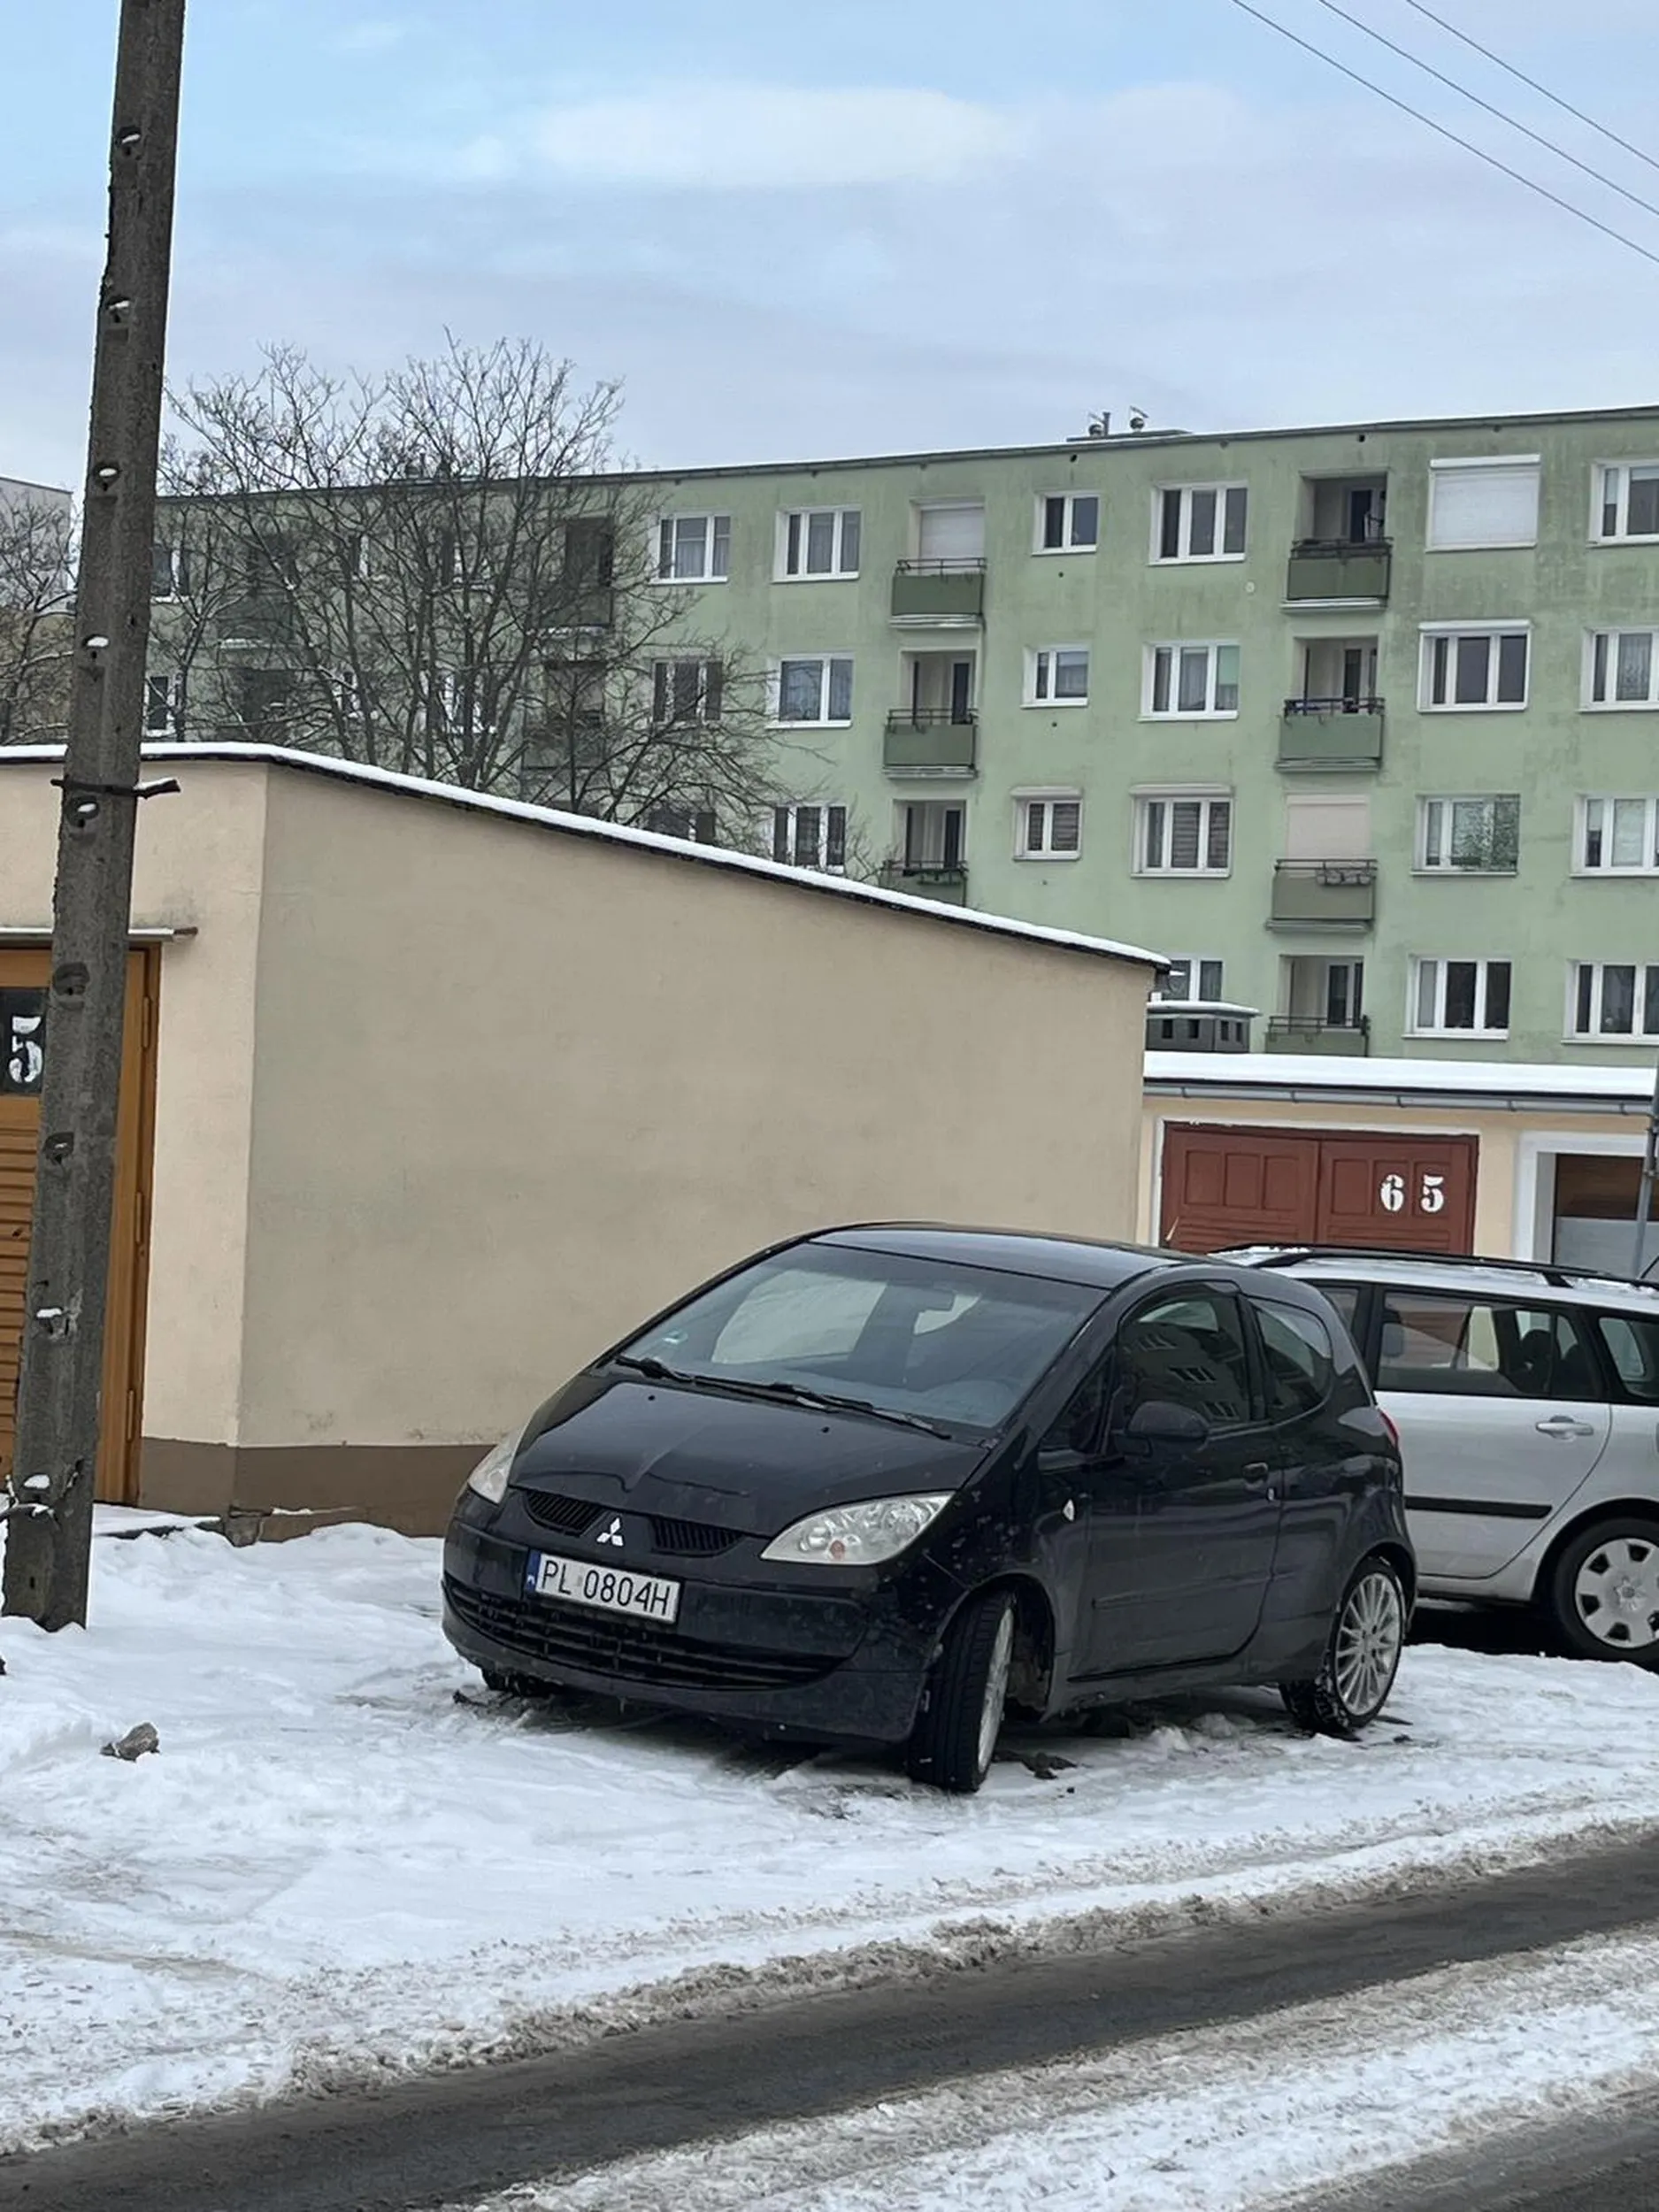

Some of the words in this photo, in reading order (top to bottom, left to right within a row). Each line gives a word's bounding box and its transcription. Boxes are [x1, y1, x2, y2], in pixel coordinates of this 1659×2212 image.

[9, 1015, 43, 1083] 5
[541, 1560, 572, 1595] PL
[583, 1570, 671, 1617] 0804H
